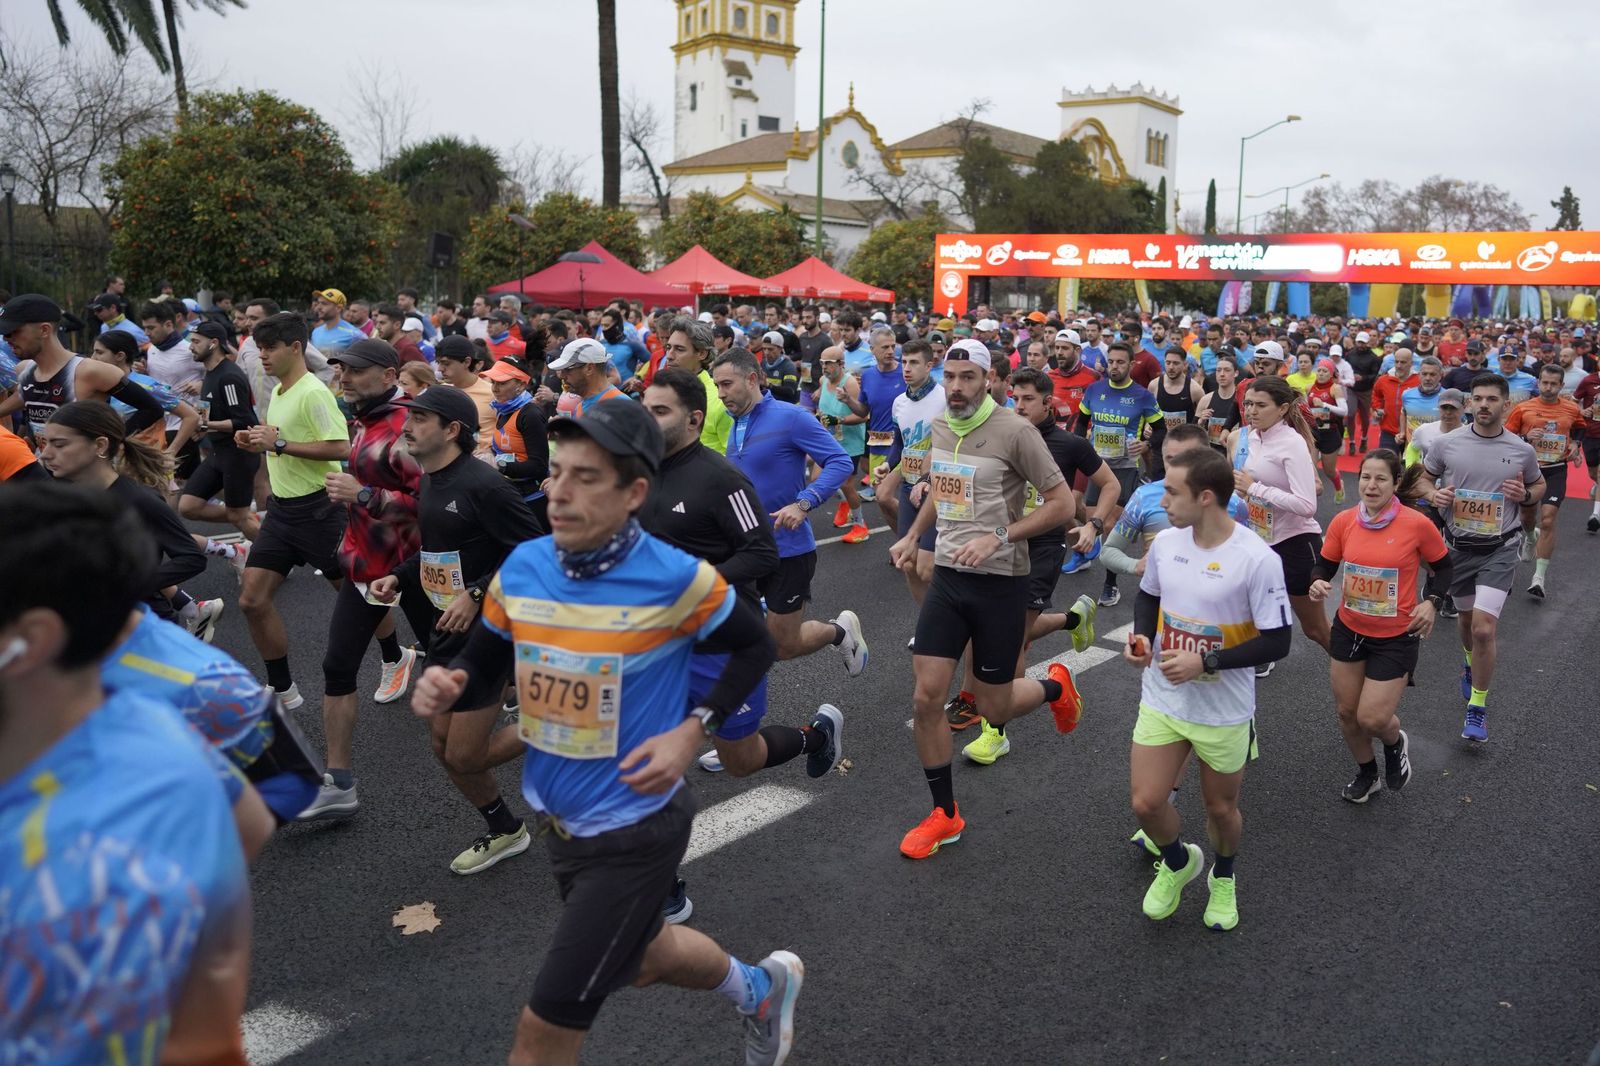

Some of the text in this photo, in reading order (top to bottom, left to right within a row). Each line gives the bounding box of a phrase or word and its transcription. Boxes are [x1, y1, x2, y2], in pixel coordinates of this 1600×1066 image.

[1347, 248, 1401, 266] HOKA
[1093, 411, 1130, 425] TUSSAM
[1096, 434, 1120, 444] 13386
[1537, 441, 1559, 449] 4982
[934, 475, 962, 495] 7859
[1462, 500, 1492, 516] 7841
[1351, 575, 1384, 595] 7317
[529, 670, 590, 712] 5779
